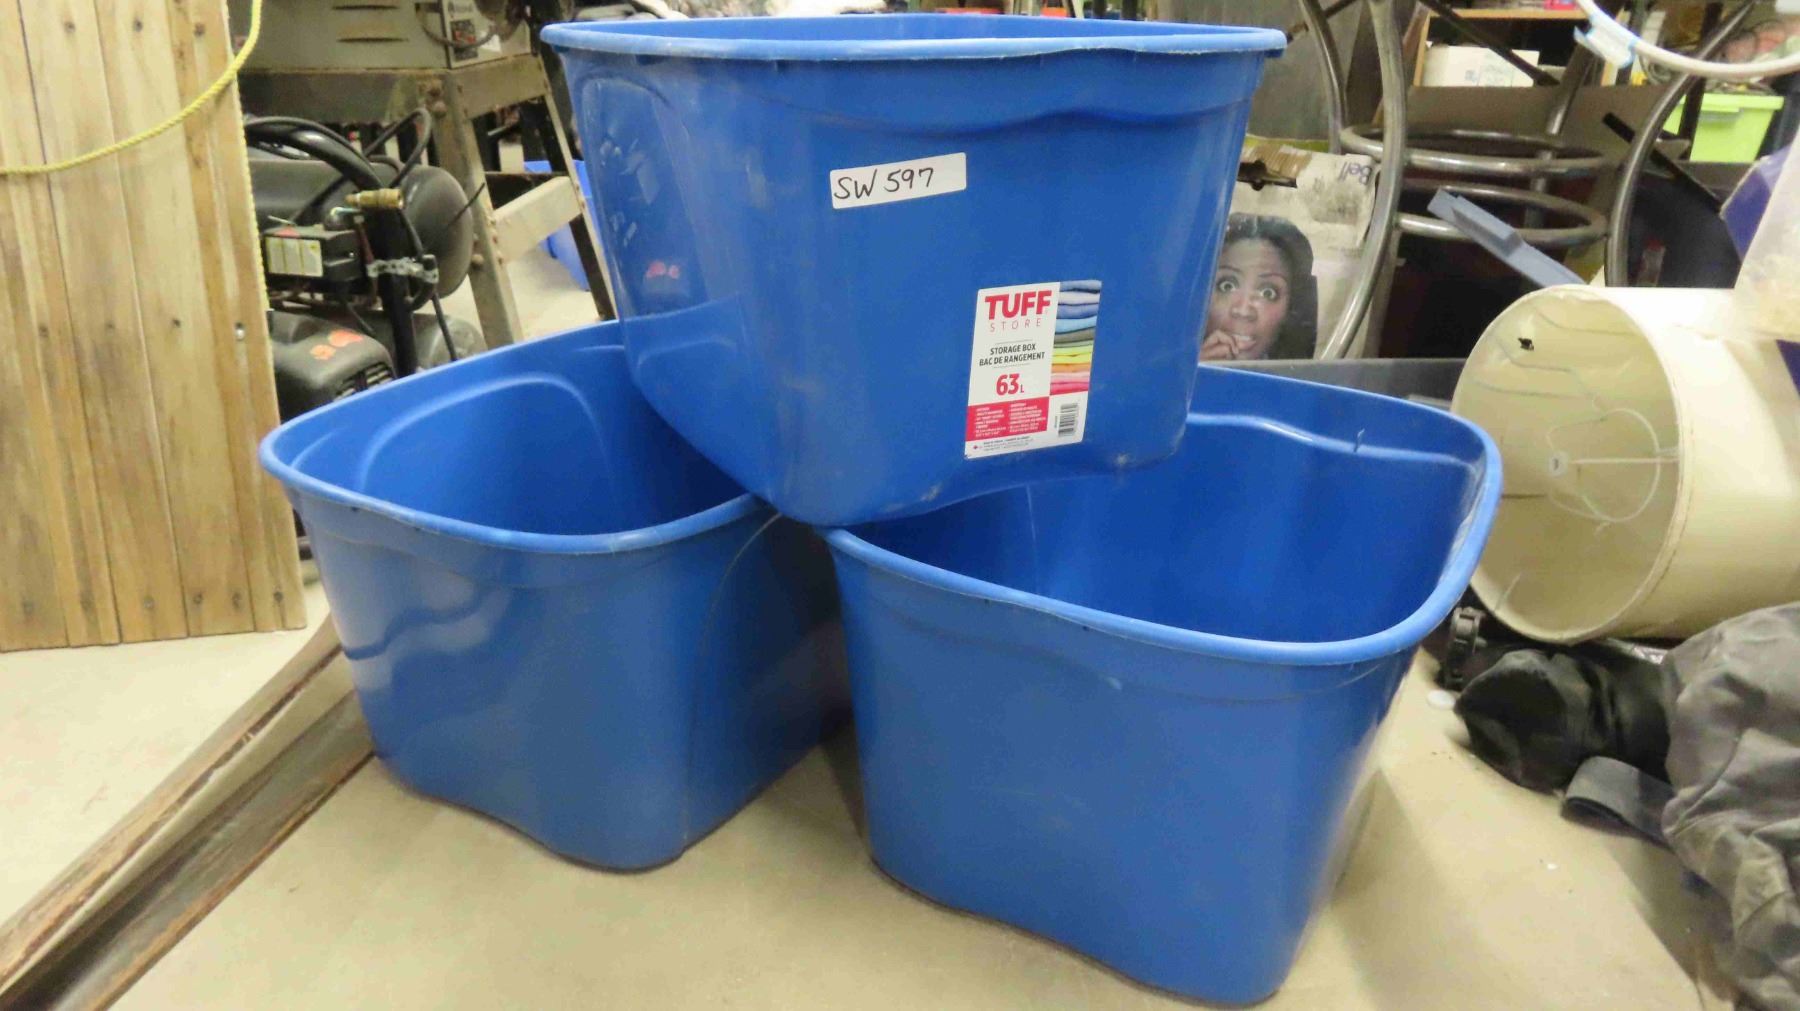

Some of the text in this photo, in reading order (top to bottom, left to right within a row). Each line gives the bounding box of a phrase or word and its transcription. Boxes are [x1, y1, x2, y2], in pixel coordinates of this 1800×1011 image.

[834, 167, 934, 199] SW 597
[985, 290, 1052, 320] TUFF
[989, 318, 1042, 332] STORE
[990, 343, 1036, 355] STORAGE BOX
[979, 352, 1045, 366] BAC DE RANGEMENT
